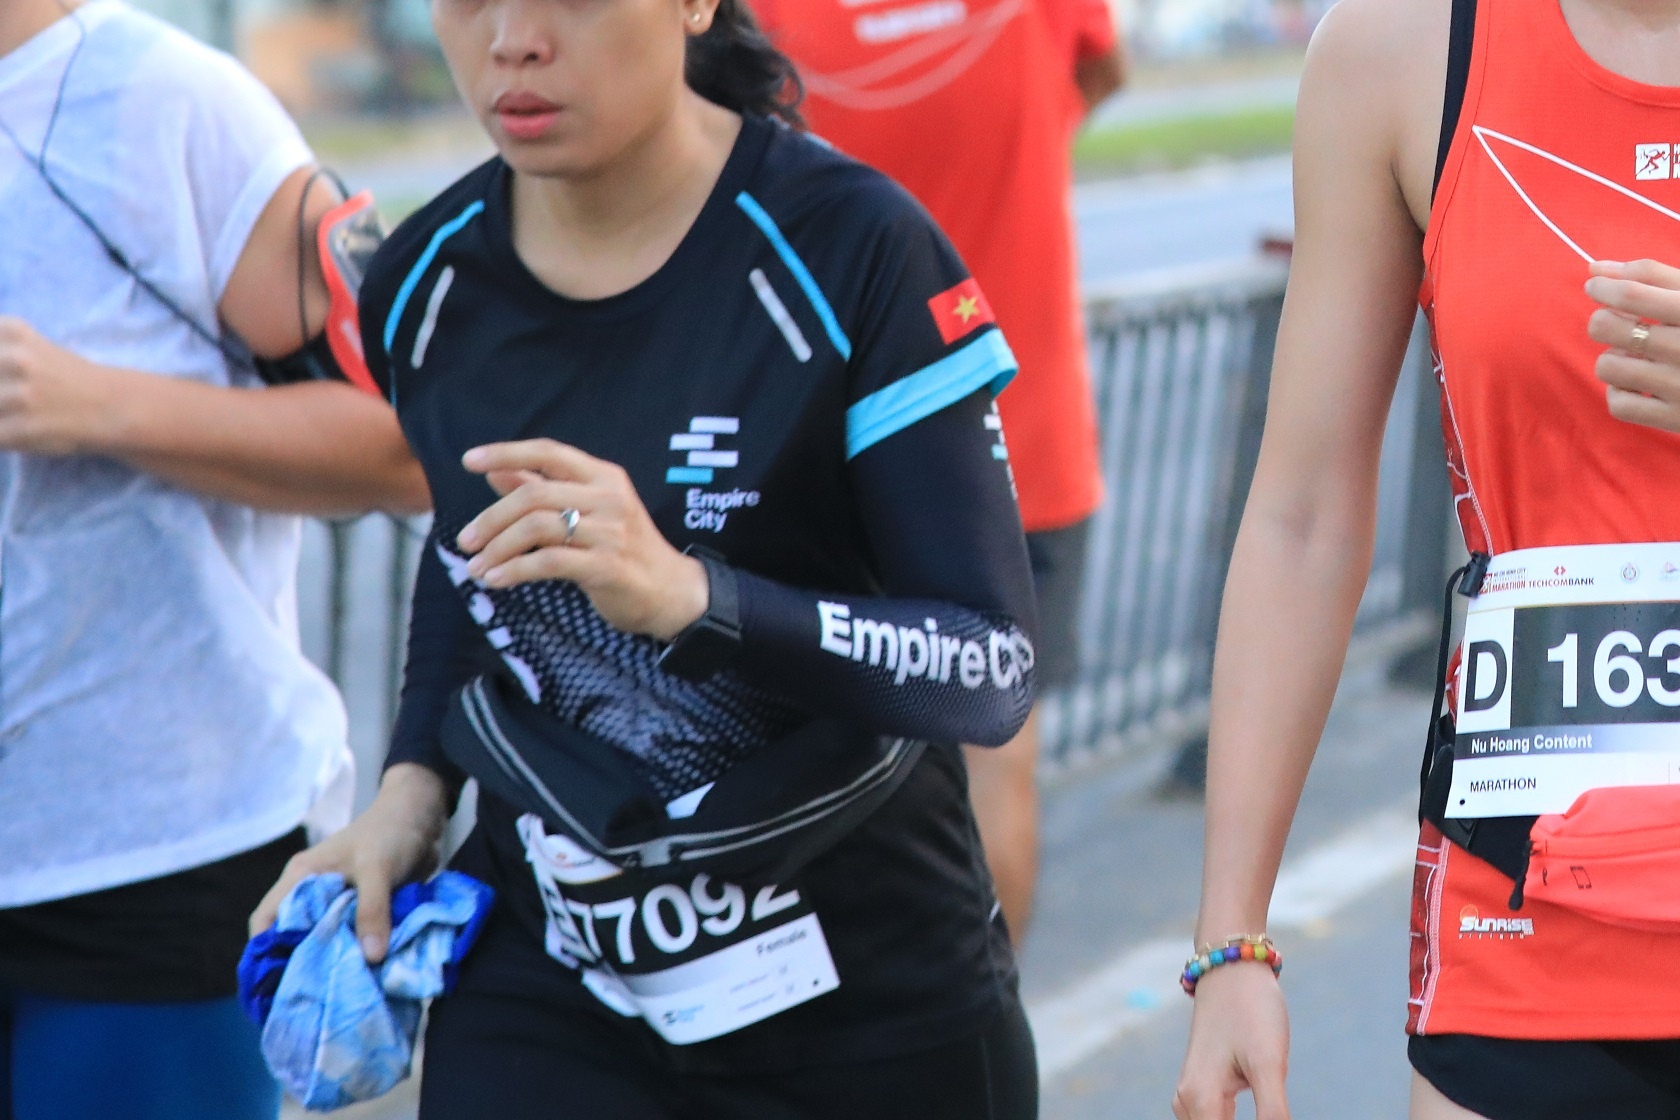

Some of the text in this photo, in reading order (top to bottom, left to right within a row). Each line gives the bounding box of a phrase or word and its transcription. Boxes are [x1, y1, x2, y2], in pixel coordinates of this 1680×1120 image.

[686, 487, 760, 512] Empire
[684, 509, 728, 533] City
[1492, 580, 1526, 592] MARATHON
[1529, 577, 1595, 589] TECHCOMBANK
[817, 600, 987, 690] Empire
[1463, 639, 1508, 713] D
[1471, 733, 1593, 754] Nu Hoang Content
[1469, 778, 1537, 793] MARATHON
